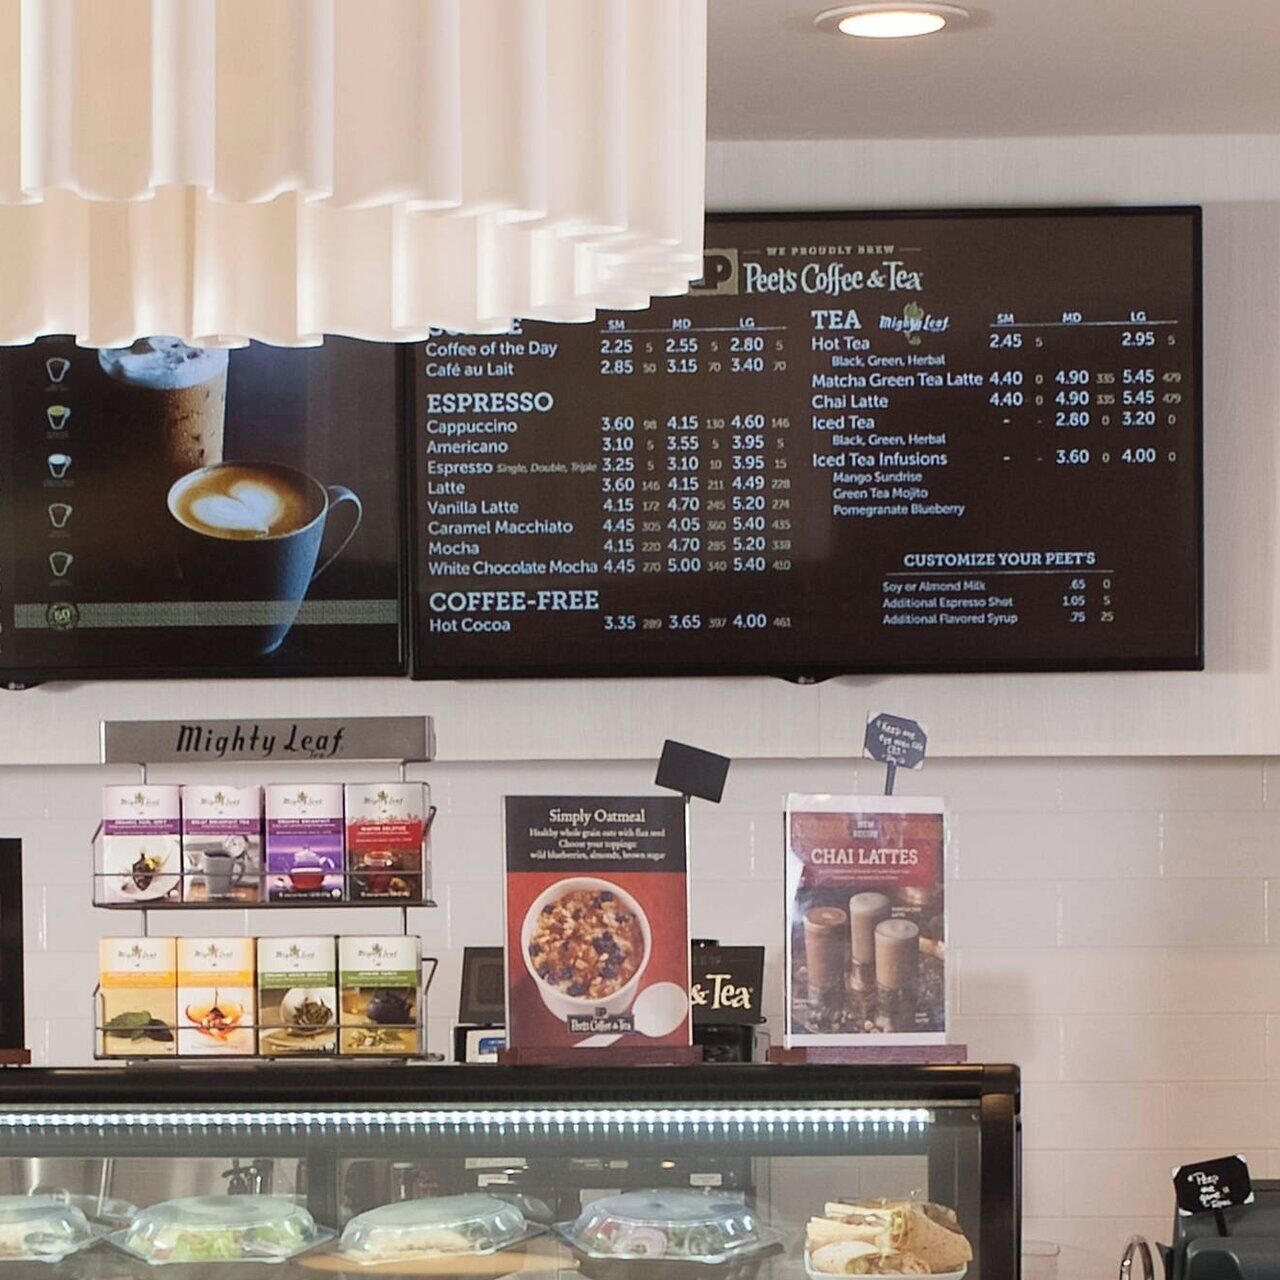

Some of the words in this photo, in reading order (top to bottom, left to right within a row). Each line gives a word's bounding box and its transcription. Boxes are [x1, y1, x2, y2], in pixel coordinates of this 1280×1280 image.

[792, 246, 852, 256] PROUDLY
[858, 245, 894, 255] BREW
[801, 263, 864, 295] Coffee
[866, 270, 884, 287] &
[883, 261, 920, 291] Tea
[811, 310, 861, 329] TEA
[426, 342, 476, 356] Coffee
[480, 342, 496, 356] of
[500, 341, 524, 355] the
[529, 341, 557, 357] Day
[601, 339, 632, 353] 2.25
[666, 338, 697, 352] 2.55
[731, 337, 763, 351] 2.80
[812, 337, 839, 350] Hot
[843, 336, 869, 350] Tea
[990, 334, 1022, 347] 2.45
[1122, 332, 1154, 346] 2.95
[426, 363, 460, 376] Café
[465, 366, 483, 376] au
[488, 362, 513, 375] Lait
[812, 374, 866, 388] Matcha
[869, 373, 914, 387] Green
[917, 373, 943, 386] Tea
[947, 373, 983, 386] Latte
[427, 392, 553, 413] ESPRESSO
[812, 395, 846, 408] Chai
[851, 395, 888, 408] Latte
[427, 419, 517, 436] Cappuccino
[813, 416, 844, 429] Iced
[848, 415, 874, 429] Tea
[427, 440, 508, 453] Americano
[813, 453, 845, 467] Iced
[849, 453, 875, 466] Tea
[880, 452, 947, 466] Infusions
[428, 461, 493, 476] Espresso
[428, 482, 465, 494] Latte
[428, 501, 477, 514] Vanilla
[482, 501, 518, 514] Latte
[428, 521, 491, 535] Caramel
[496, 520, 573, 534] Macchiato
[429, 541, 479, 555] Mocha
[904, 553, 995, 566] CUSTOMIZE
[998, 553, 1041, 565] YOUR
[1046, 552, 1095, 565] PEET'S
[429, 562, 470, 575] White
[473, 561, 546, 575] Chocolate
[550, 560, 598, 573] Mocha
[430, 591, 599, 611] COFFEE-FREE
[430, 619, 457, 632] Hot
[461, 618, 510, 631] Cocoa
[605, 616, 636, 630] 3.35
[669, 615, 701, 629] 3.65
[733, 614, 766, 627] 4.00
[176, 725, 276, 759] Mighty
[284, 725, 346, 756] Leaf
[549, 808, 592, 826] Simply
[594, 808, 646, 823] Oatmeal
[811, 848, 854, 864] CHAI
[858, 848, 918, 865] LATTES
[692, 984, 709, 1005] &
[705, 974, 752, 1010] Tea
